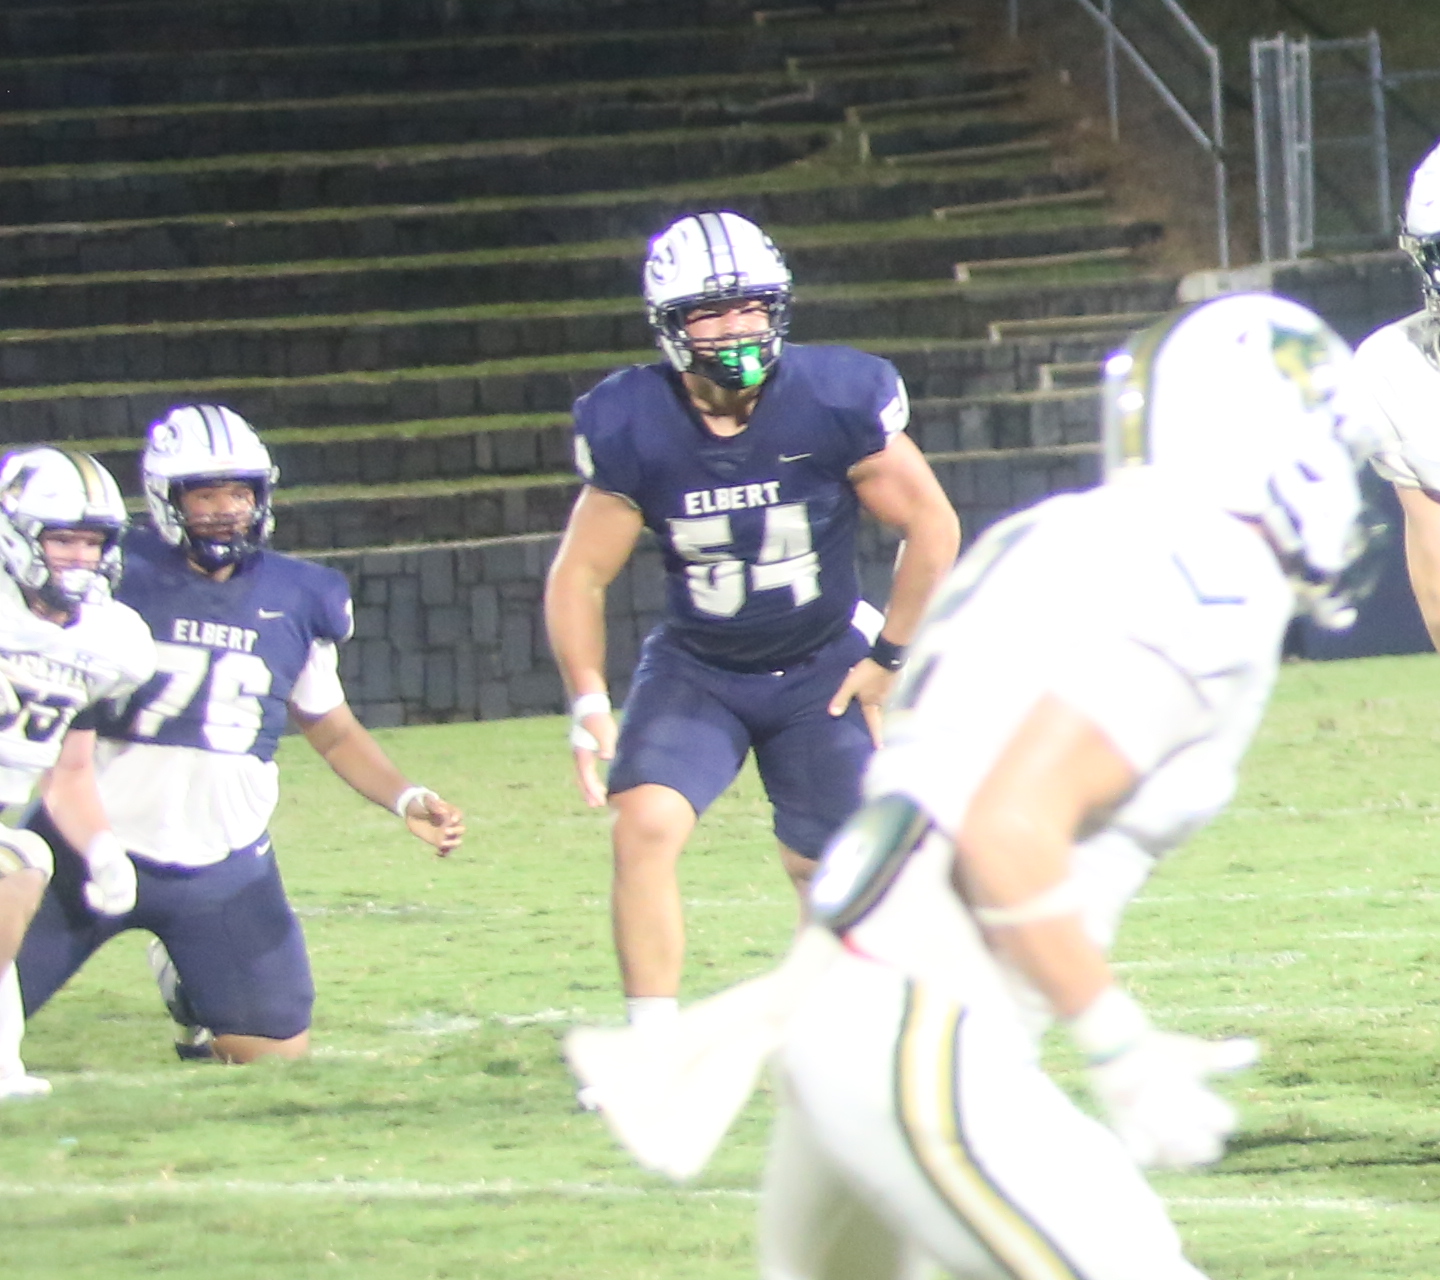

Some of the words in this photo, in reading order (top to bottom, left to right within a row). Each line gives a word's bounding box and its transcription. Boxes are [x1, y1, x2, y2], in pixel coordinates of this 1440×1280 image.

[683, 480, 782, 516] ELBERT
[664, 501, 823, 619] 54
[172, 618, 259, 653] ELBERT
[134, 639, 273, 754] 76
